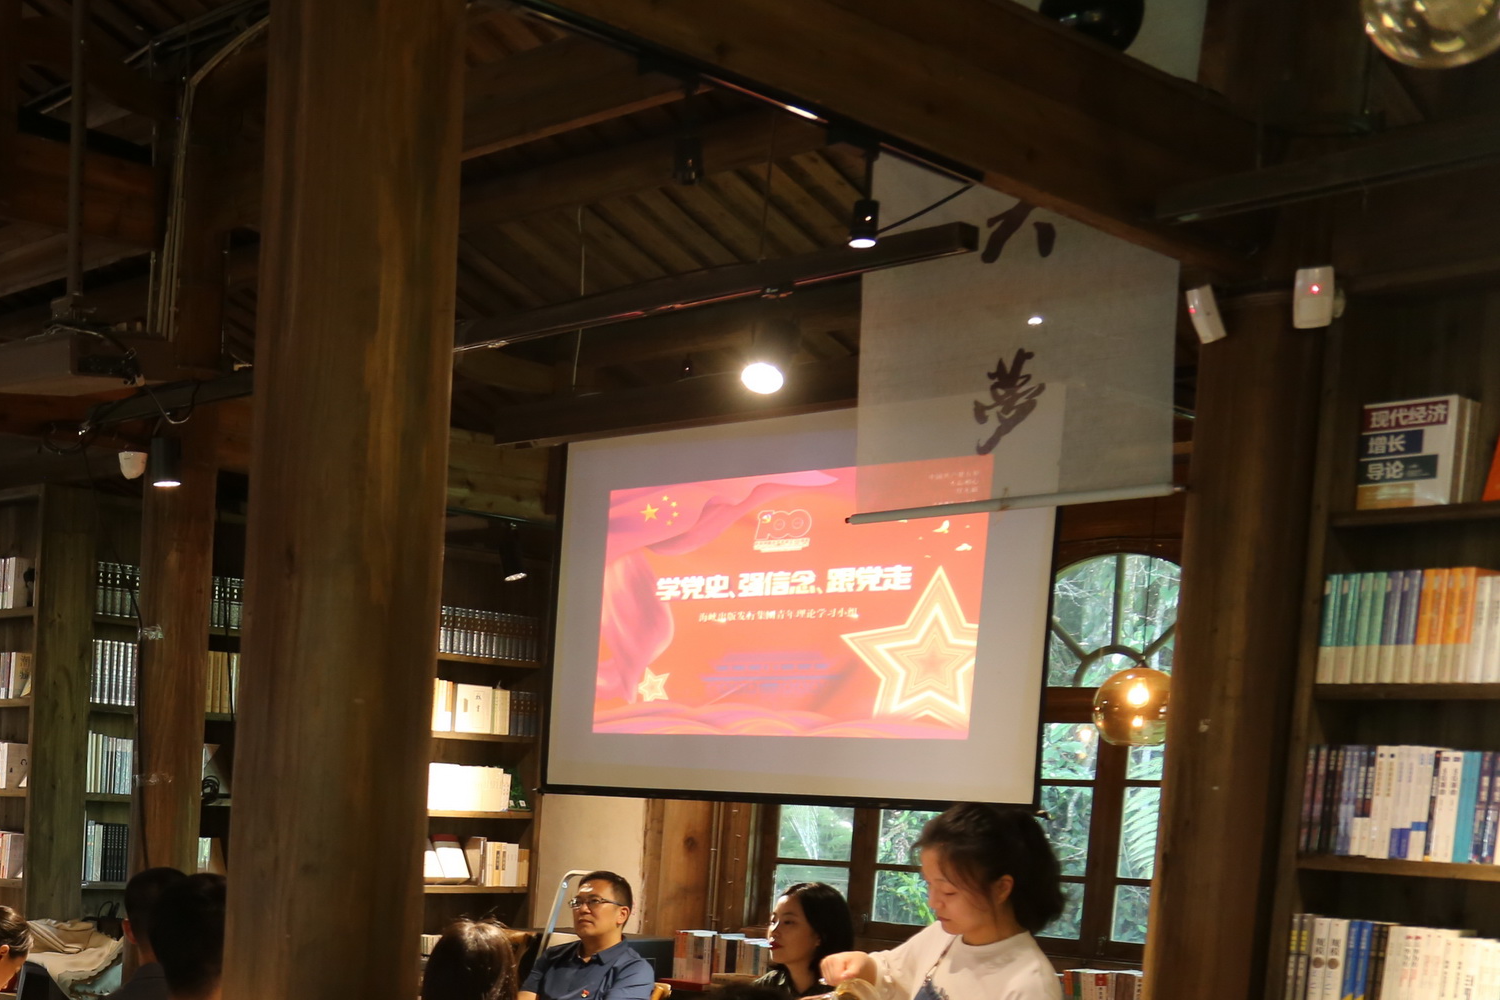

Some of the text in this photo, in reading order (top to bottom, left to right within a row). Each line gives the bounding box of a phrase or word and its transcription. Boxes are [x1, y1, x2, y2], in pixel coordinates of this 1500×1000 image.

[1370, 403, 1447, 428] 现代经济
[1368, 434, 1406, 454] 增长
[1366, 460, 1404, 481] 导论
[655, 564, 913, 602] 学党史、强信念、跟党走
